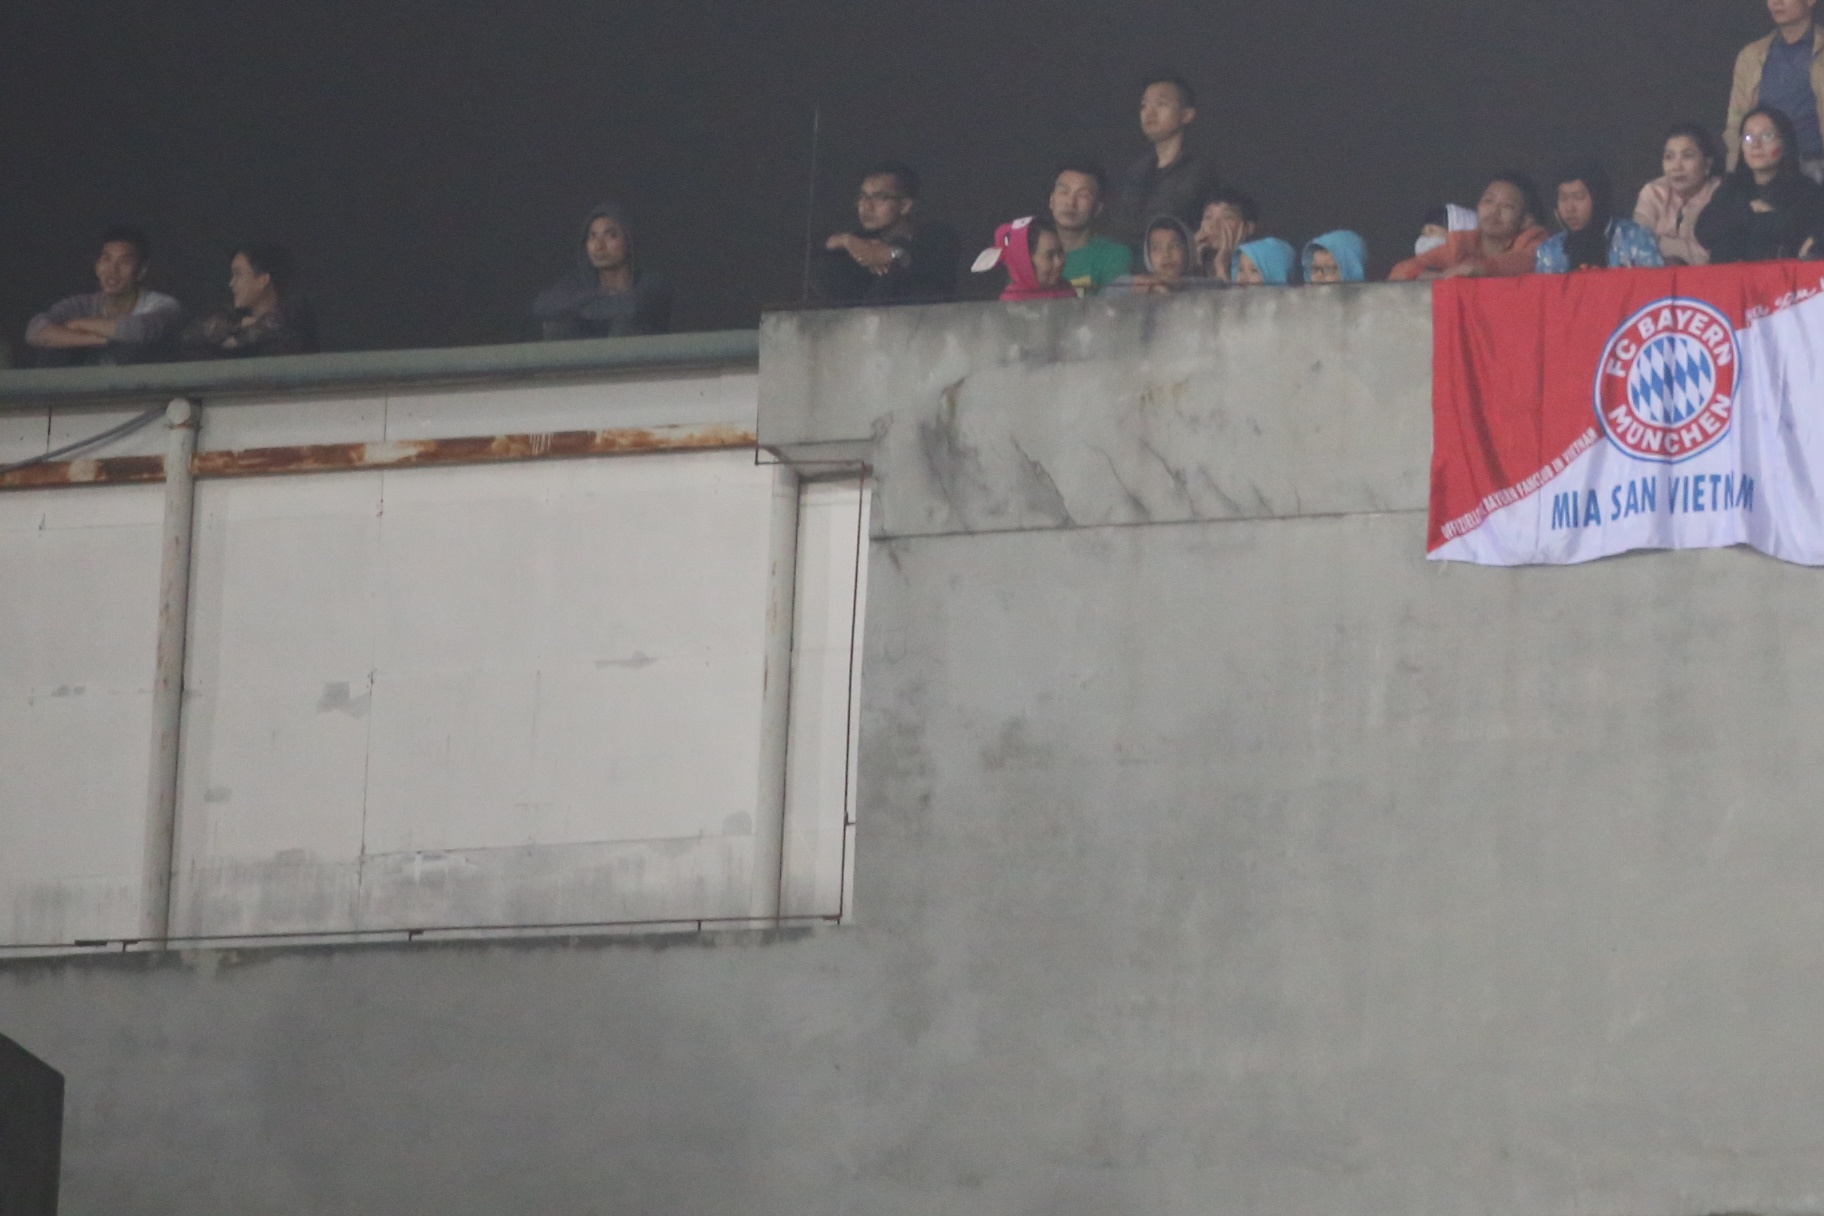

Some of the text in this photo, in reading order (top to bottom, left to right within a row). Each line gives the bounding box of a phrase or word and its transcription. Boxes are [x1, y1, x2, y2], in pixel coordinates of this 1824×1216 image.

[1606, 308, 1733, 378] FC BAYERN
[1551, 488, 1602, 530] MIA
[1611, 476, 1656, 521] SAN
